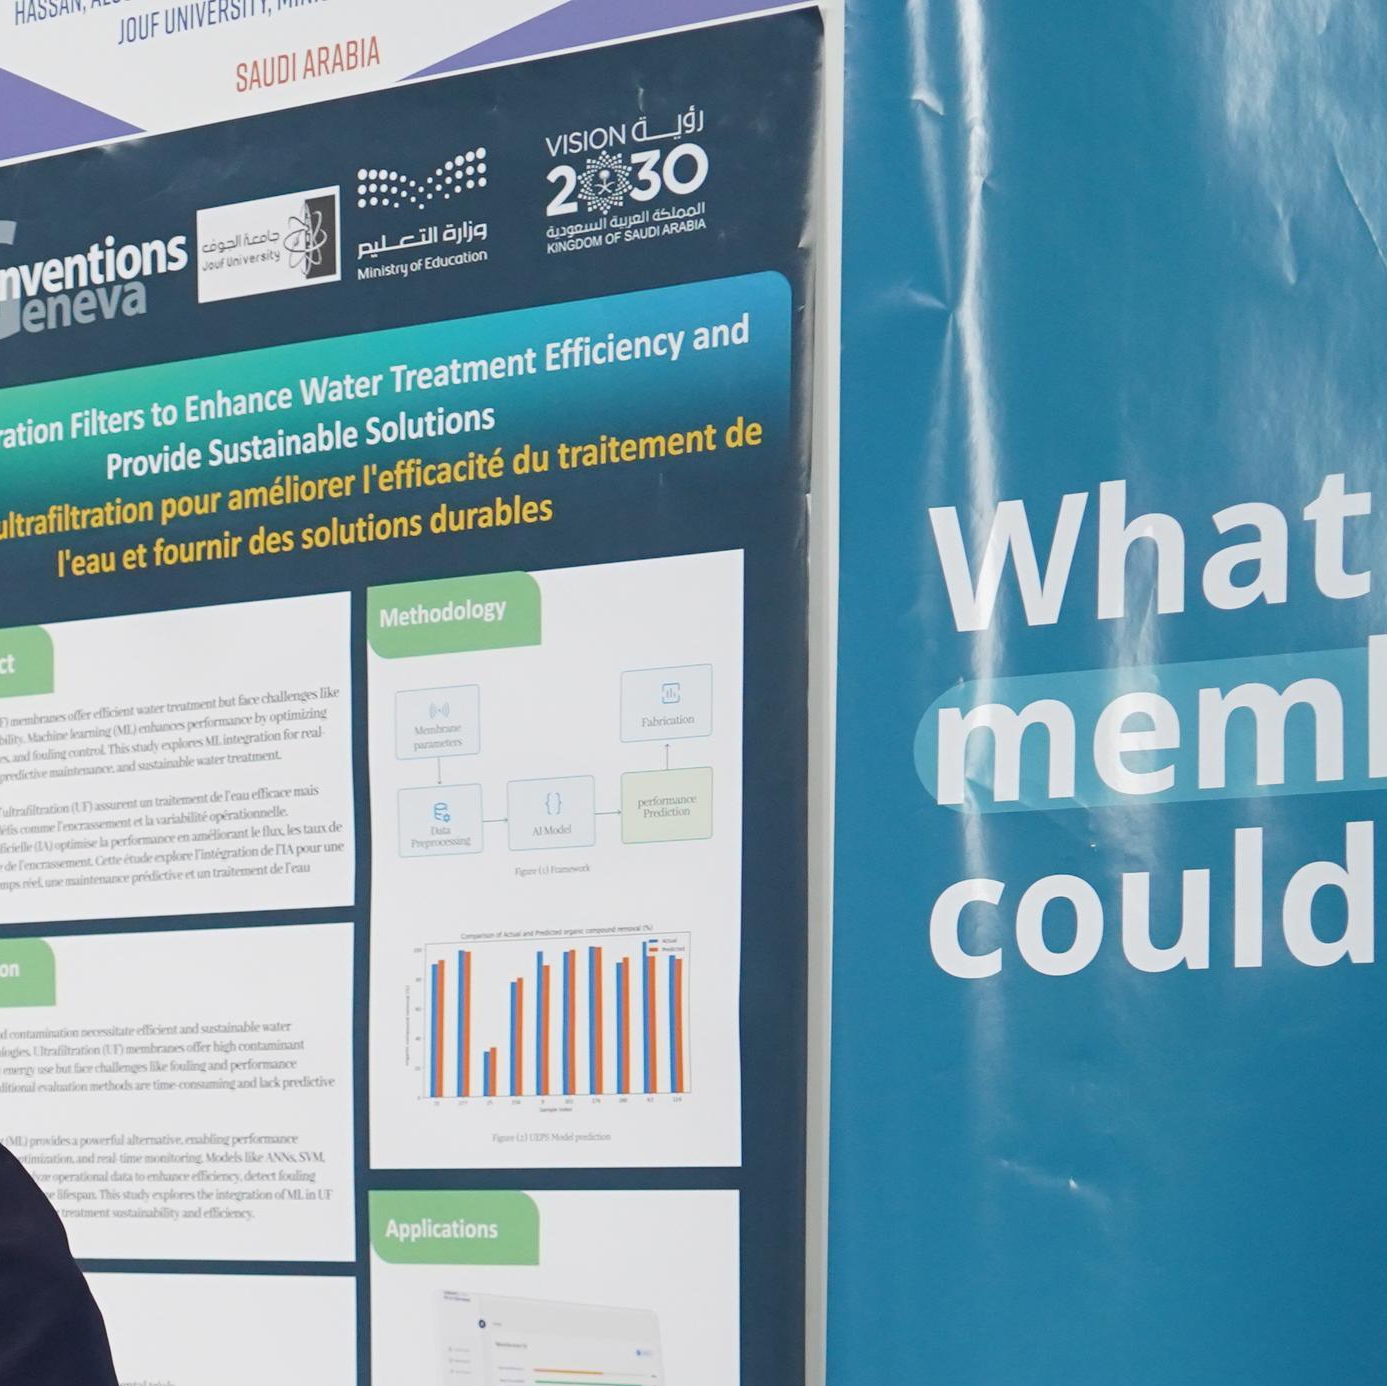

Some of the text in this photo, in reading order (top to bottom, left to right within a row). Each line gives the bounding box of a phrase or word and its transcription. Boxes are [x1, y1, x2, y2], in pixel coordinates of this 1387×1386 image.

[118, 0, 272, 45] JOUF UNIVERSITY,
[236, 36, 380, 92] SAUDI ARABIA
[631, 104, 705, 143] رؤية
[545, 123, 626, 158] VISION
[545, 201, 706, 239] المملكة العربية السعودية
[546, 218, 707, 254] KINGDOM OF SAUDI ARABIA
[357, 221, 488, 259] وزارة التعليم
[202, 249, 280, 271] Jouf University
[357, 250, 488, 281] Ministry of Education
[71, 406, 145, 439] Filters
[151, 402, 178, 426] to
[185, 387, 292, 423] Enhance
[299, 371, 383, 406] Water
[390, 348, 537, 394] Treatment
[545, 330, 685, 372] Efficiency
[692, 313, 750, 350] and
[107, 406, 495, 480] Provide Sustainable Solutions
[161, 492, 221, 526] pour
[228, 474, 357, 512] améliorer
[362, 448, 504, 494] l'efficacité
[512, 444, 550, 475] du
[557, 422, 717, 470] traitement
[724, 416, 763, 448] de
[58, 494, 554, 577] l'eau et fournir des solutions durables
[927, 473, 1372, 633] What
[379, 600, 507, 629] Methodology
[10, 712, 66, 727] membranes
[68, 709, 91, 721] offer
[93, 704, 134, 720] efficient
[136, 703, 164, 715] water
[166, 698, 216, 713] treatment
[218, 696, 236, 708] but
[238, 693, 259, 706] face
[261, 689, 318, 705] challenges
[320, 686, 340, 699] like
[641, 714, 695, 728] Fabrication
[28, 729, 69, 743] Machine
[70, 726, 112, 740] learning
[138, 720, 185, 734] enhances
[187, 715, 253, 732] performance
[255, 712, 267, 724] by
[270, 708, 327, 722] optimizing
[414, 722, 462, 736] Membrane
[413, 736, 463, 751] parameters
[637, 795, 697, 809] performance
[643, 805, 691, 818] Prediction
[411, 835, 471, 849] Preprocessing
[430, 825, 451, 836] Data
[533, 824, 572, 836] AI Model
[550, 863, 590, 874] Framework
[928, 820, 1376, 979] could
[9, 1027, 79, 1040] contamination
[81, 1024, 135, 1038] necessitate
[136, 1025, 178, 1036] efficient
[180, 1023, 199, 1035] and
[201, 1021, 261, 1034] sustainable
[263, 1022, 292, 1033] water
[551, 1131, 574, 1142] Model
[575, 1130, 611, 1145] prediction
[385, 1218, 498, 1241] Applications
